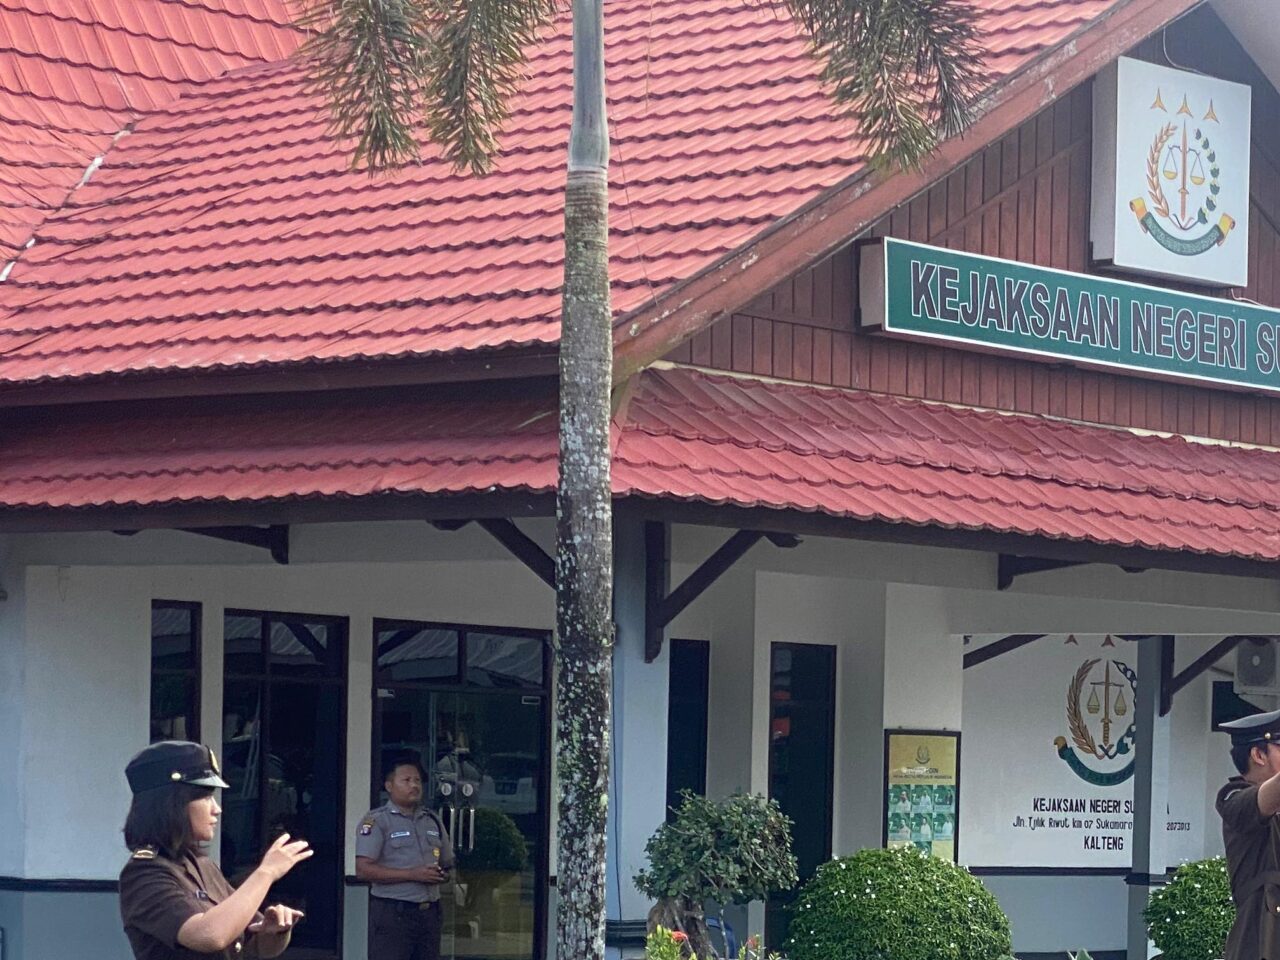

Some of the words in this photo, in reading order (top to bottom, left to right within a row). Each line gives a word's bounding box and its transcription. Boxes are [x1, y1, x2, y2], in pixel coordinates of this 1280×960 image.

[911, 260, 1120, 350] KEJAKSAAN
[1131, 300, 1247, 370] NEGERI
[1033, 798, 1086, 813] KEJAKSAAN
[1089, 799, 1121, 814] NEGERI
[1049, 817, 1070, 829] Riwut
[1072, 818, 1083, 829] km
[1096, 818, 1133, 830] Sukamara
[1084, 835, 1124, 851] KALTENG
